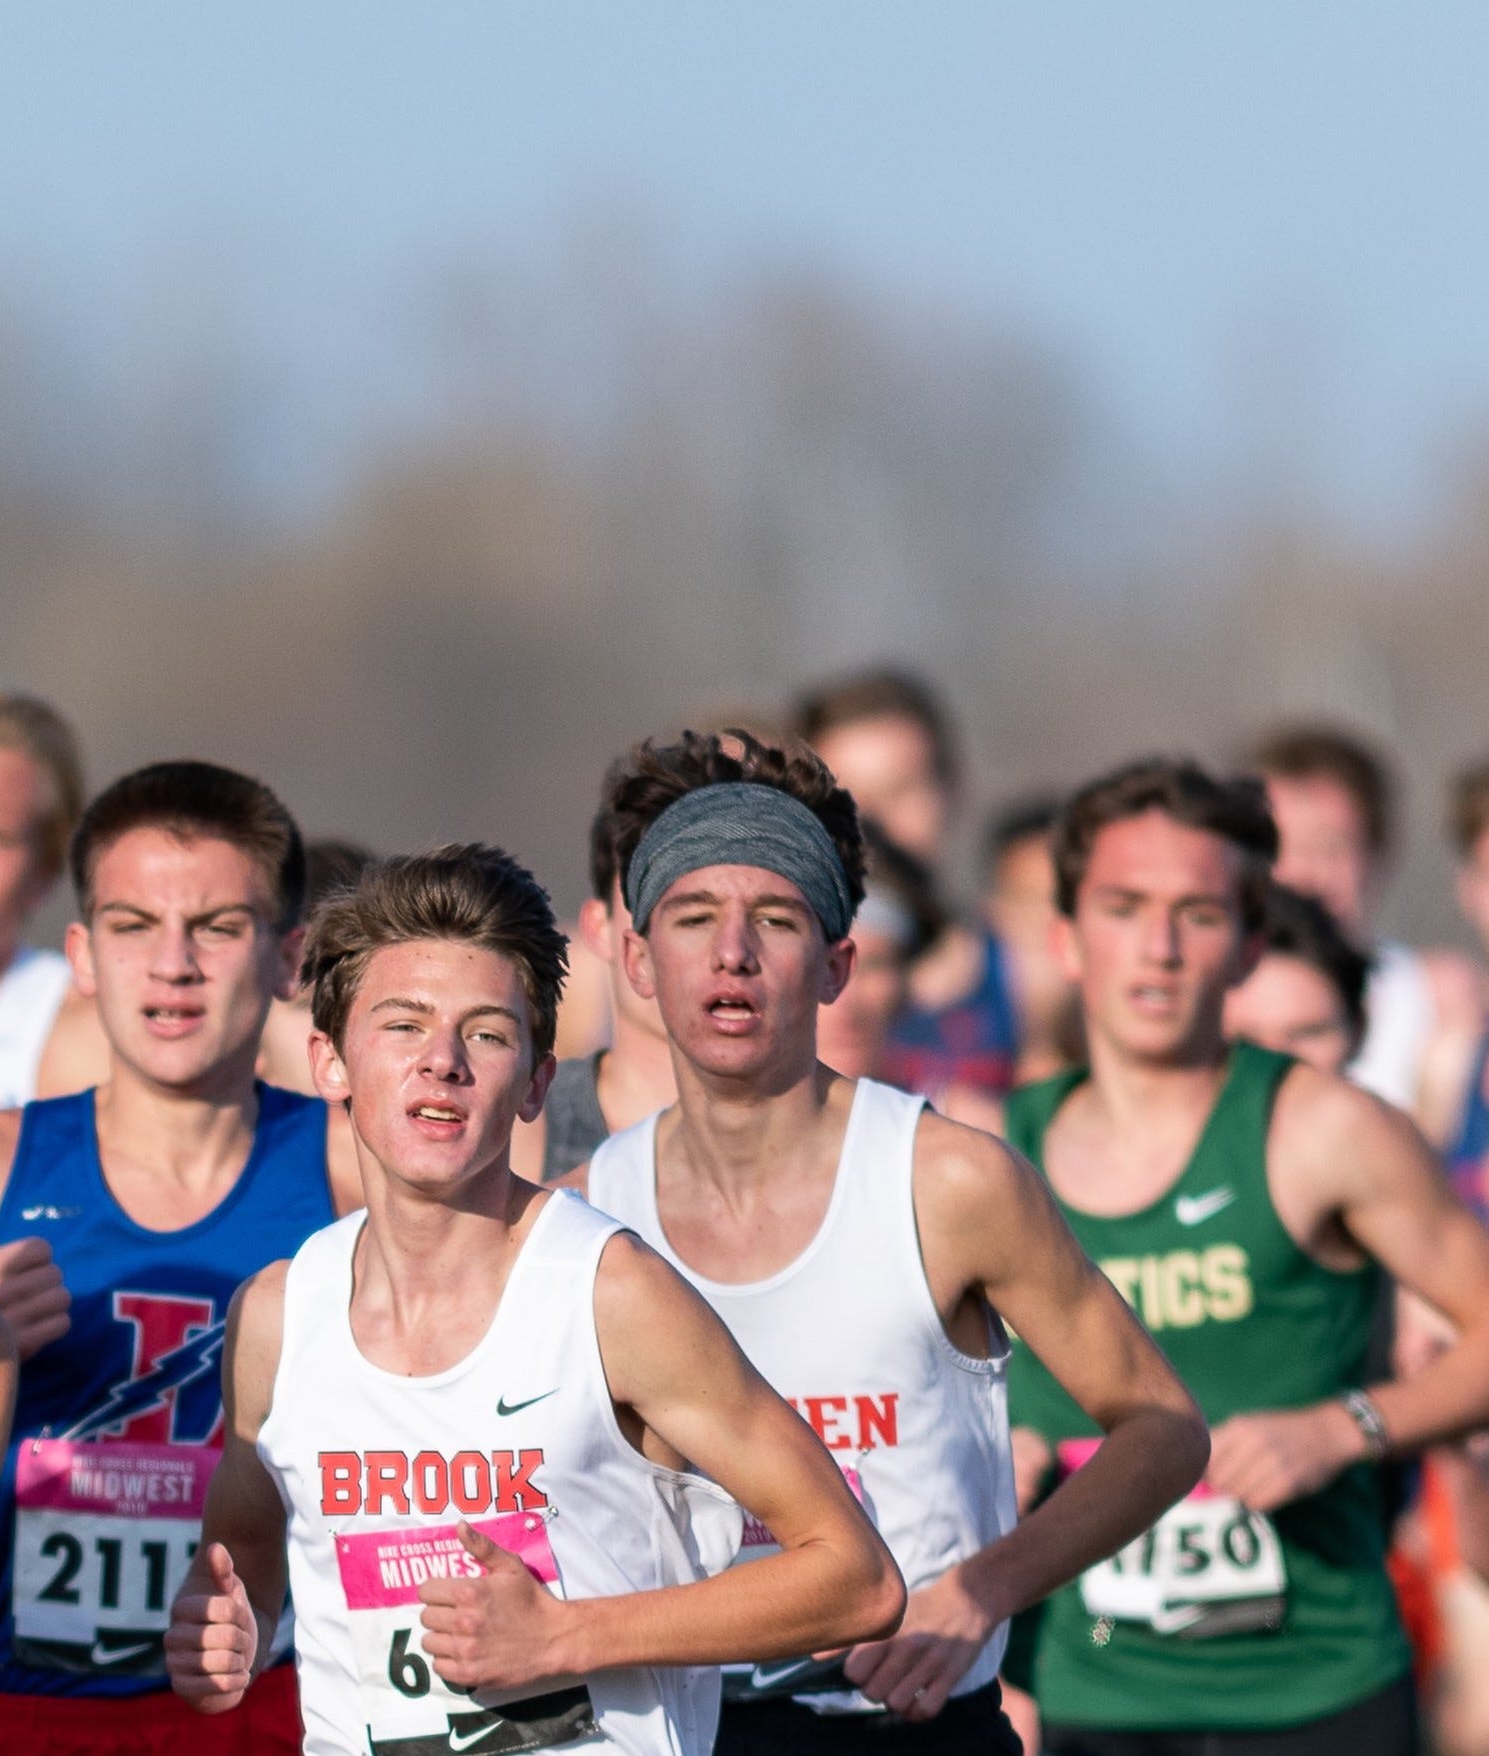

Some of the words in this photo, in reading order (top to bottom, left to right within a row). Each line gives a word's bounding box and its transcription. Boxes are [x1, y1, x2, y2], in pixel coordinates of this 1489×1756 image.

[1098, 1242, 1254, 1330] TICS
[786, 1393, 899, 1450] EN
[71, 1470, 193, 1502] MIDWEST
[318, 1448, 548, 1516] BROOK
[38, 1532, 199, 1611] 211
[379, 1551, 482, 1589] MIDWES
[400, 1541, 433, 1557] CROSS
